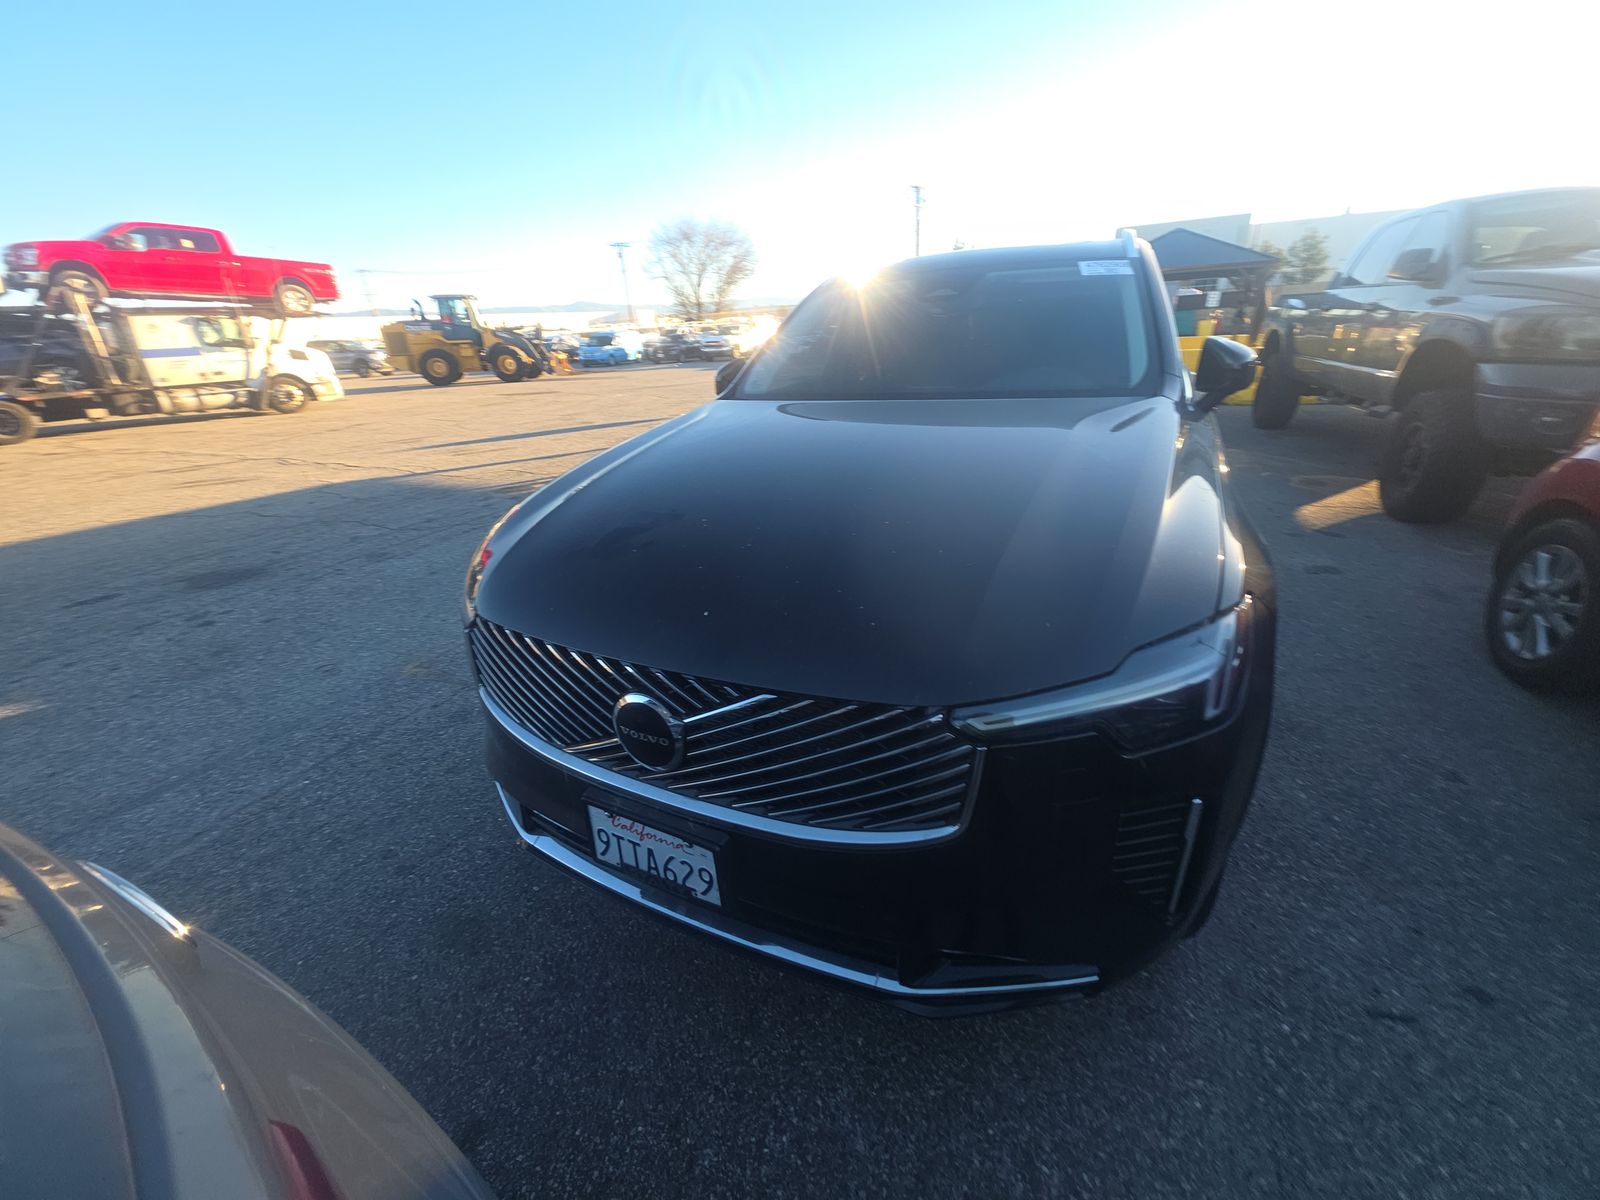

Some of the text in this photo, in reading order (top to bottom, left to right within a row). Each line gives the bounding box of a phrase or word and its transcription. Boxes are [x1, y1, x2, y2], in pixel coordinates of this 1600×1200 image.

[619, 725, 669, 746] VOLVO
[611, 814, 685, 849] California
[597, 828, 714, 896] 9TTA629
